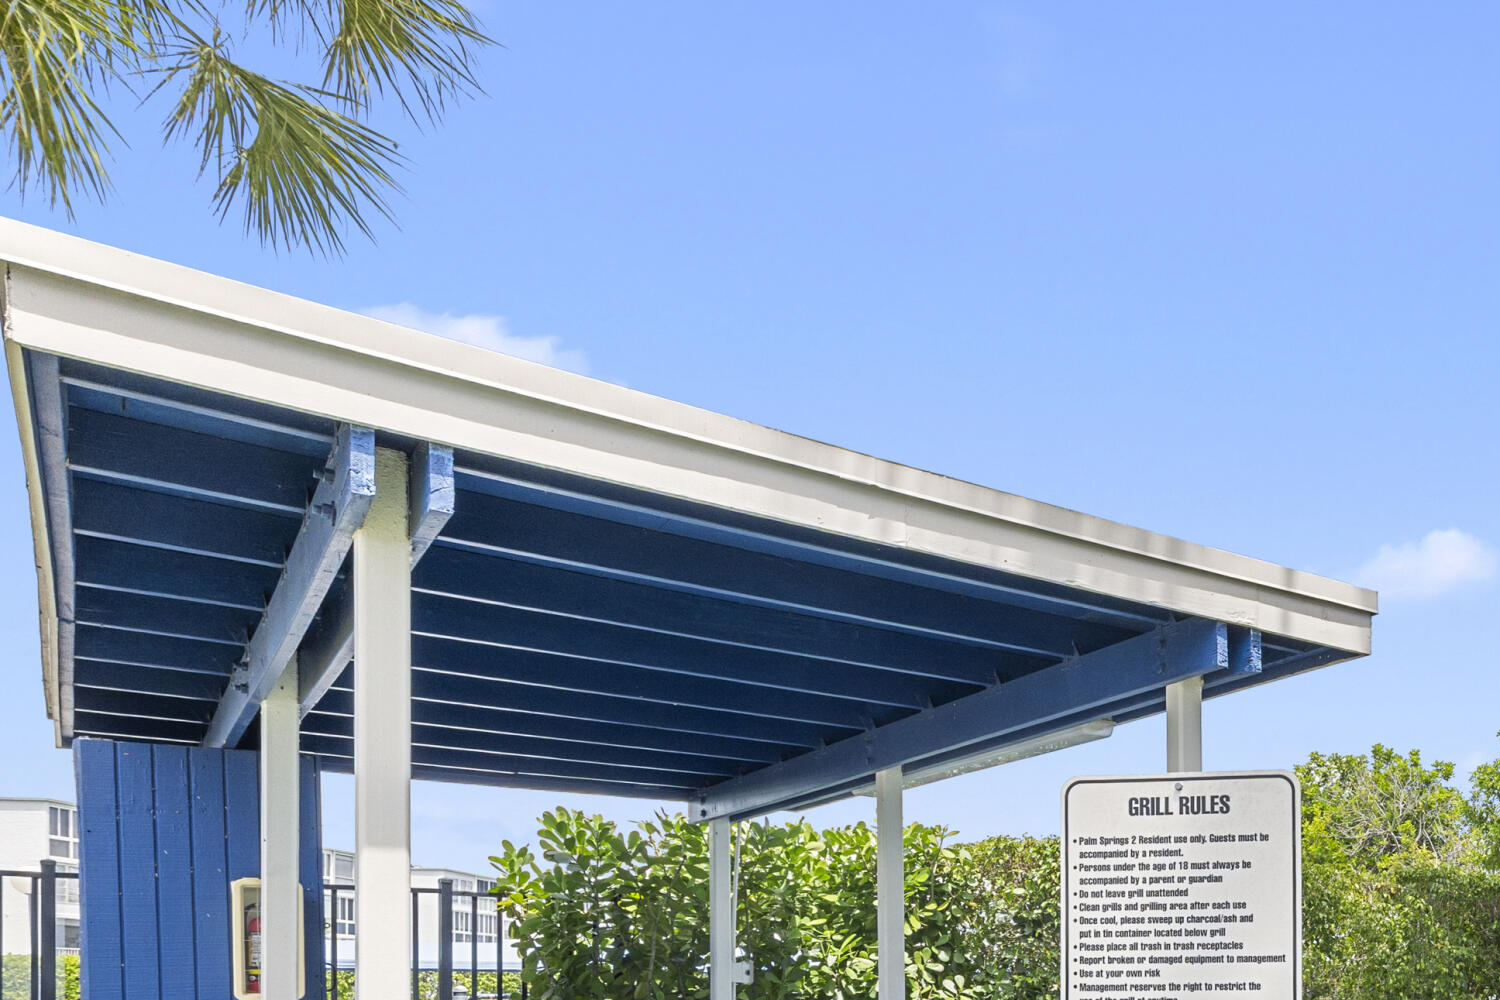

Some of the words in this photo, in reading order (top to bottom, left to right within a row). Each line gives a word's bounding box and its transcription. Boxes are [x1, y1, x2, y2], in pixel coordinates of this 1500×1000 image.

[1128, 796, 1174, 816] GRILL
[1179, 794, 1230, 815] RULES
[1079, 837, 1097, 845] Palm
[1099, 836, 1129, 846] Springs
[1131, 835, 1136, 844] 2
[1138, 835, 1172, 844] Resident
[1174, 836, 1188, 844] use
[1190, 834, 1207, 844] only.
[1209, 833, 1236, 843] Guests
[1238, 833, 1258, 842] must
[1259, 832, 1269, 842] be
[1079, 849, 1128, 860] accompanied
[1130, 849, 1140, 859] by
[1142, 850, 1147, 858] a
[1149, 848, 1184, 857] resident.
[1079, 863, 1111, 872] Persons
[1113, 862, 1136, 871] under
[1138, 862, 1150, 871] the
[1152, 863, 1166, 872] age
[1168, 861, 1176, 870] of
[1179, 861, 1189, 870] 18
[1190, 861, 1210, 870] must
[1212, 860, 1240, 871] always
[1242, 860, 1252, 869] be
[1079, 876, 1128, 886] accompanied
[1130, 876, 1140, 886] by
[1149, 875, 1175, 885] parent
[1188, 874, 1223, 885] guardian
[1079, 890, 1089, 898] Do
[1091, 890, 1103, 898] not
[1105, 889, 1126, 898] leave
[1128, 889, 1144, 899] grill
[1146, 888, 1188, 897] unattended
[1079, 903, 1100, 912] Clean
[1102, 902, 1122, 912] grills
[1124, 902, 1138, 911] and
[1140, 902, 1167, 912] grilling
[1190, 901, 1210, 910] after
[1212, 900, 1231, 910] each
[1079, 916, 1098, 925] Once
[1100, 916, 1118, 925] cool,
[1120, 916, 1145, 925] please
[1147, 916, 1173, 925] sweep
[1175, 916, 1184, 925] up
[1186, 914, 1237, 924] charcoal/ash
[1239, 914, 1254, 923] and
[1079, 930, 1092, 939] put
[1094, 930, 1101, 938] in
[1103, 930, 1113, 938] tin
[1115, 929, 1152, 938] container
[1154, 928, 1182, 937] located
[1184, 928, 1208, 937] below
[1210, 928, 1226, 938] grill
[1079, 942, 1104, 951] Please
[1106, 942, 1127, 952] place
[1129, 942, 1138, 951] all
[1140, 942, 1162, 951] trash
[1164, 942, 1171, 950] in
[1173, 941, 1195, 950] trash
[1196, 941, 1244, 951] receptacles
[1079, 956, 1105, 966] Report
[1108, 956, 1135, 964] broken
[1148, 955, 1183, 965] damaged
[1184, 955, 1224, 965] equipment
[1226, 955, 1234, 963] to
[1236, 954, 1286, 964] management
[1079, 969, 1093, 978] Use
[1095, 970, 1103, 978] at
[1106, 970, 1124, 979] your
[1126, 970, 1142, 978] own
[1144, 968, 1160, 977] risk
[1079, 983, 1128, 993] Management
[1130, 984, 1166, 992] reserves
[1168, 982, 1181, 991] the
[1183, 982, 1202, 992] right
[1204, 982, 1213, 991] to
[1214, 982, 1246, 991] restrict
[1248, 982, 1261, 990] the
